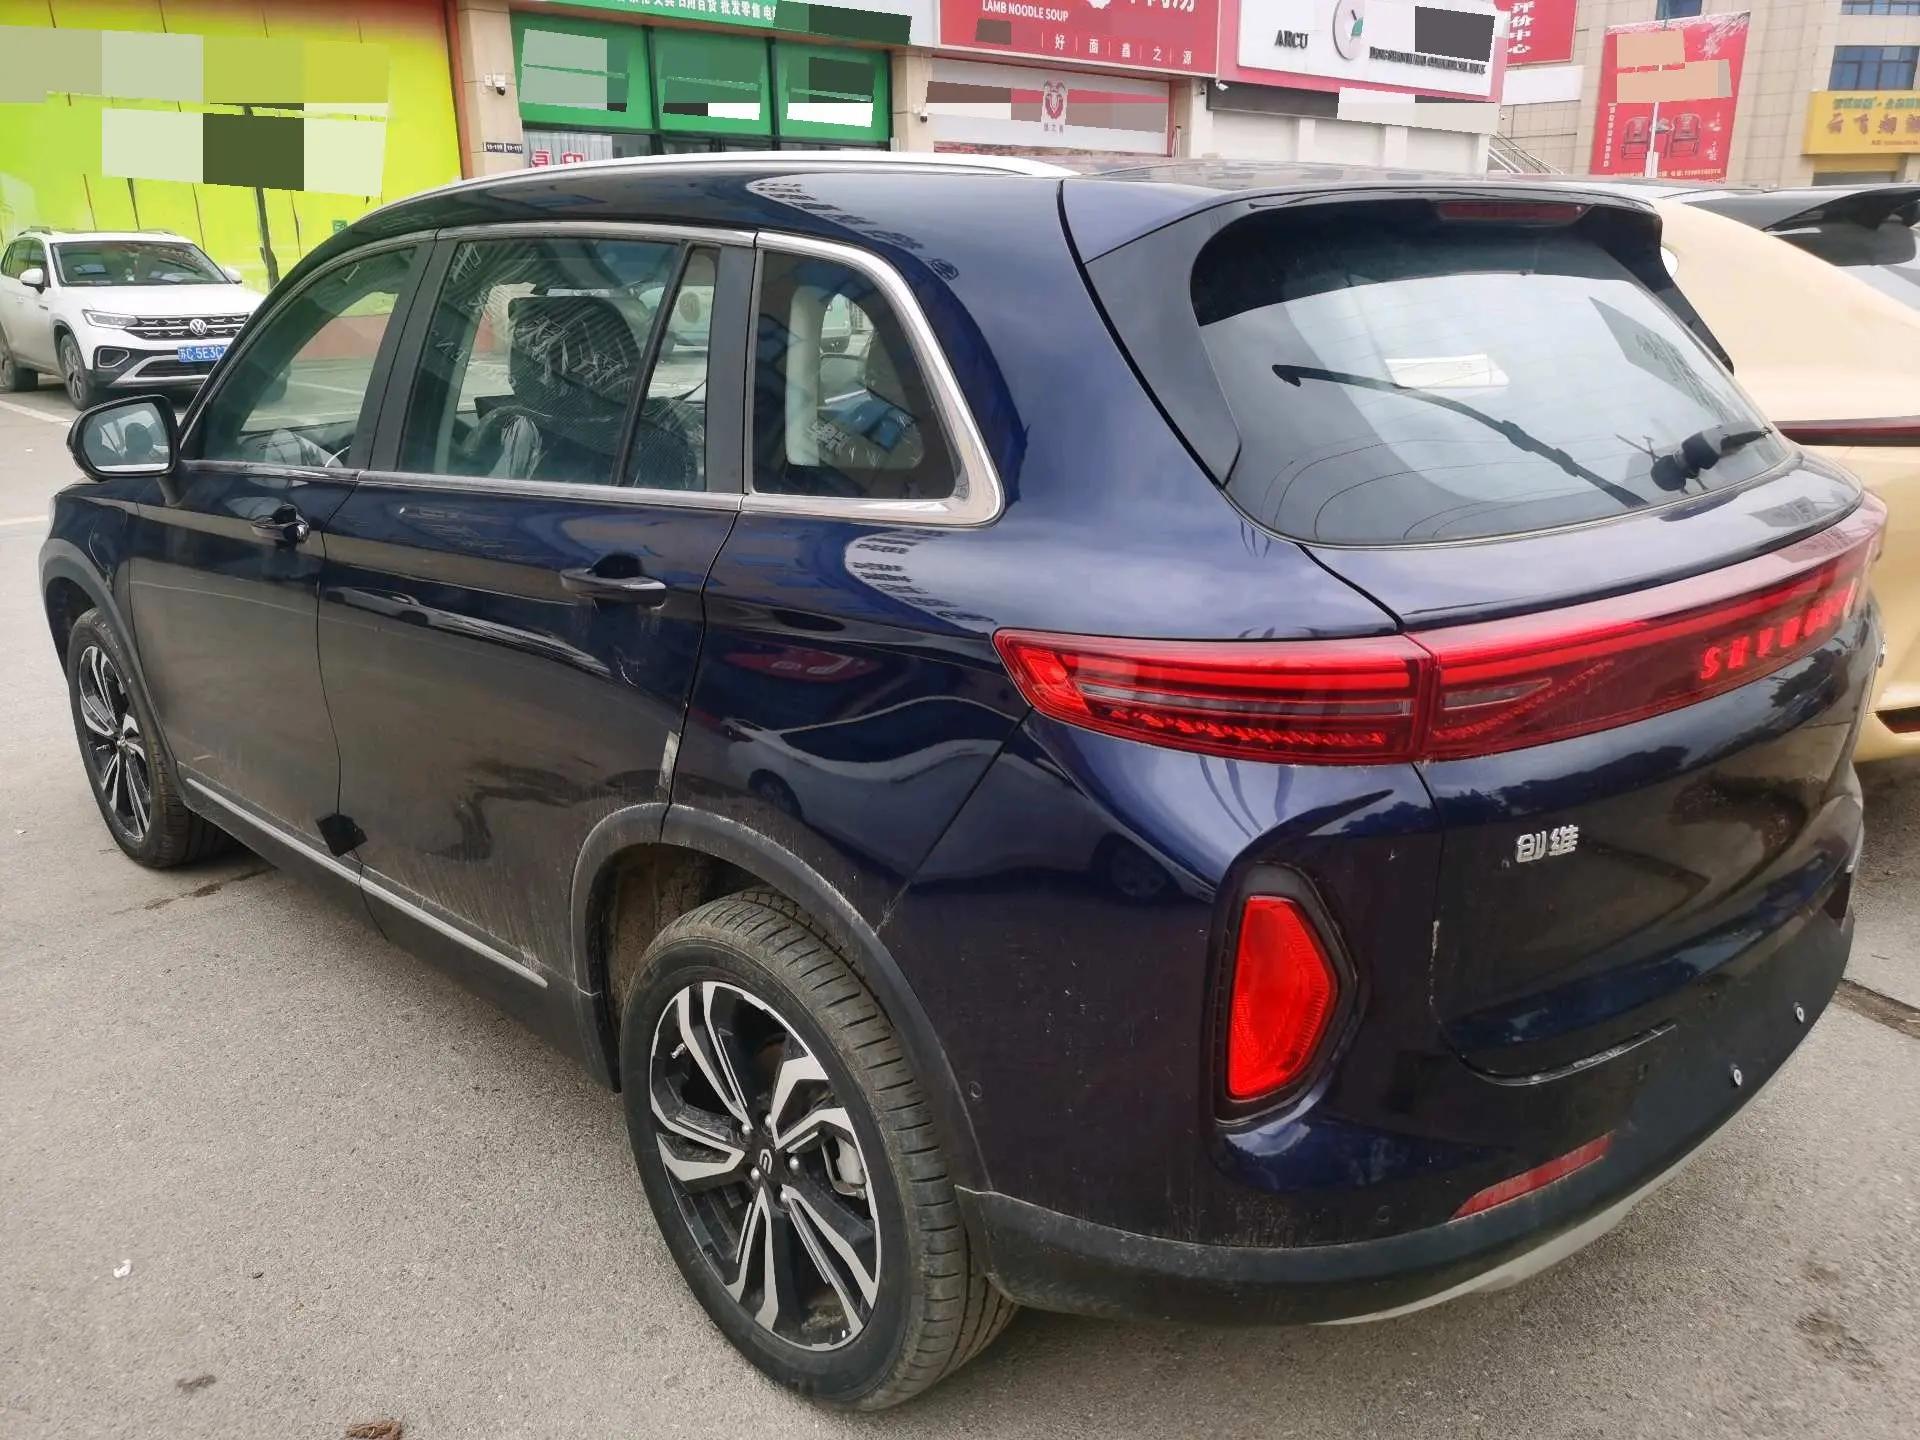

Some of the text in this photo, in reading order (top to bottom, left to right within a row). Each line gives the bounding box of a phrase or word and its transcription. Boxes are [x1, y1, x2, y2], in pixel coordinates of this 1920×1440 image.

[982, 0, 1069, 22] LAMB NOODLE SOUP
[1274, 29, 1309, 50] ARCU
[1515, 824, 1580, 864] 创维
